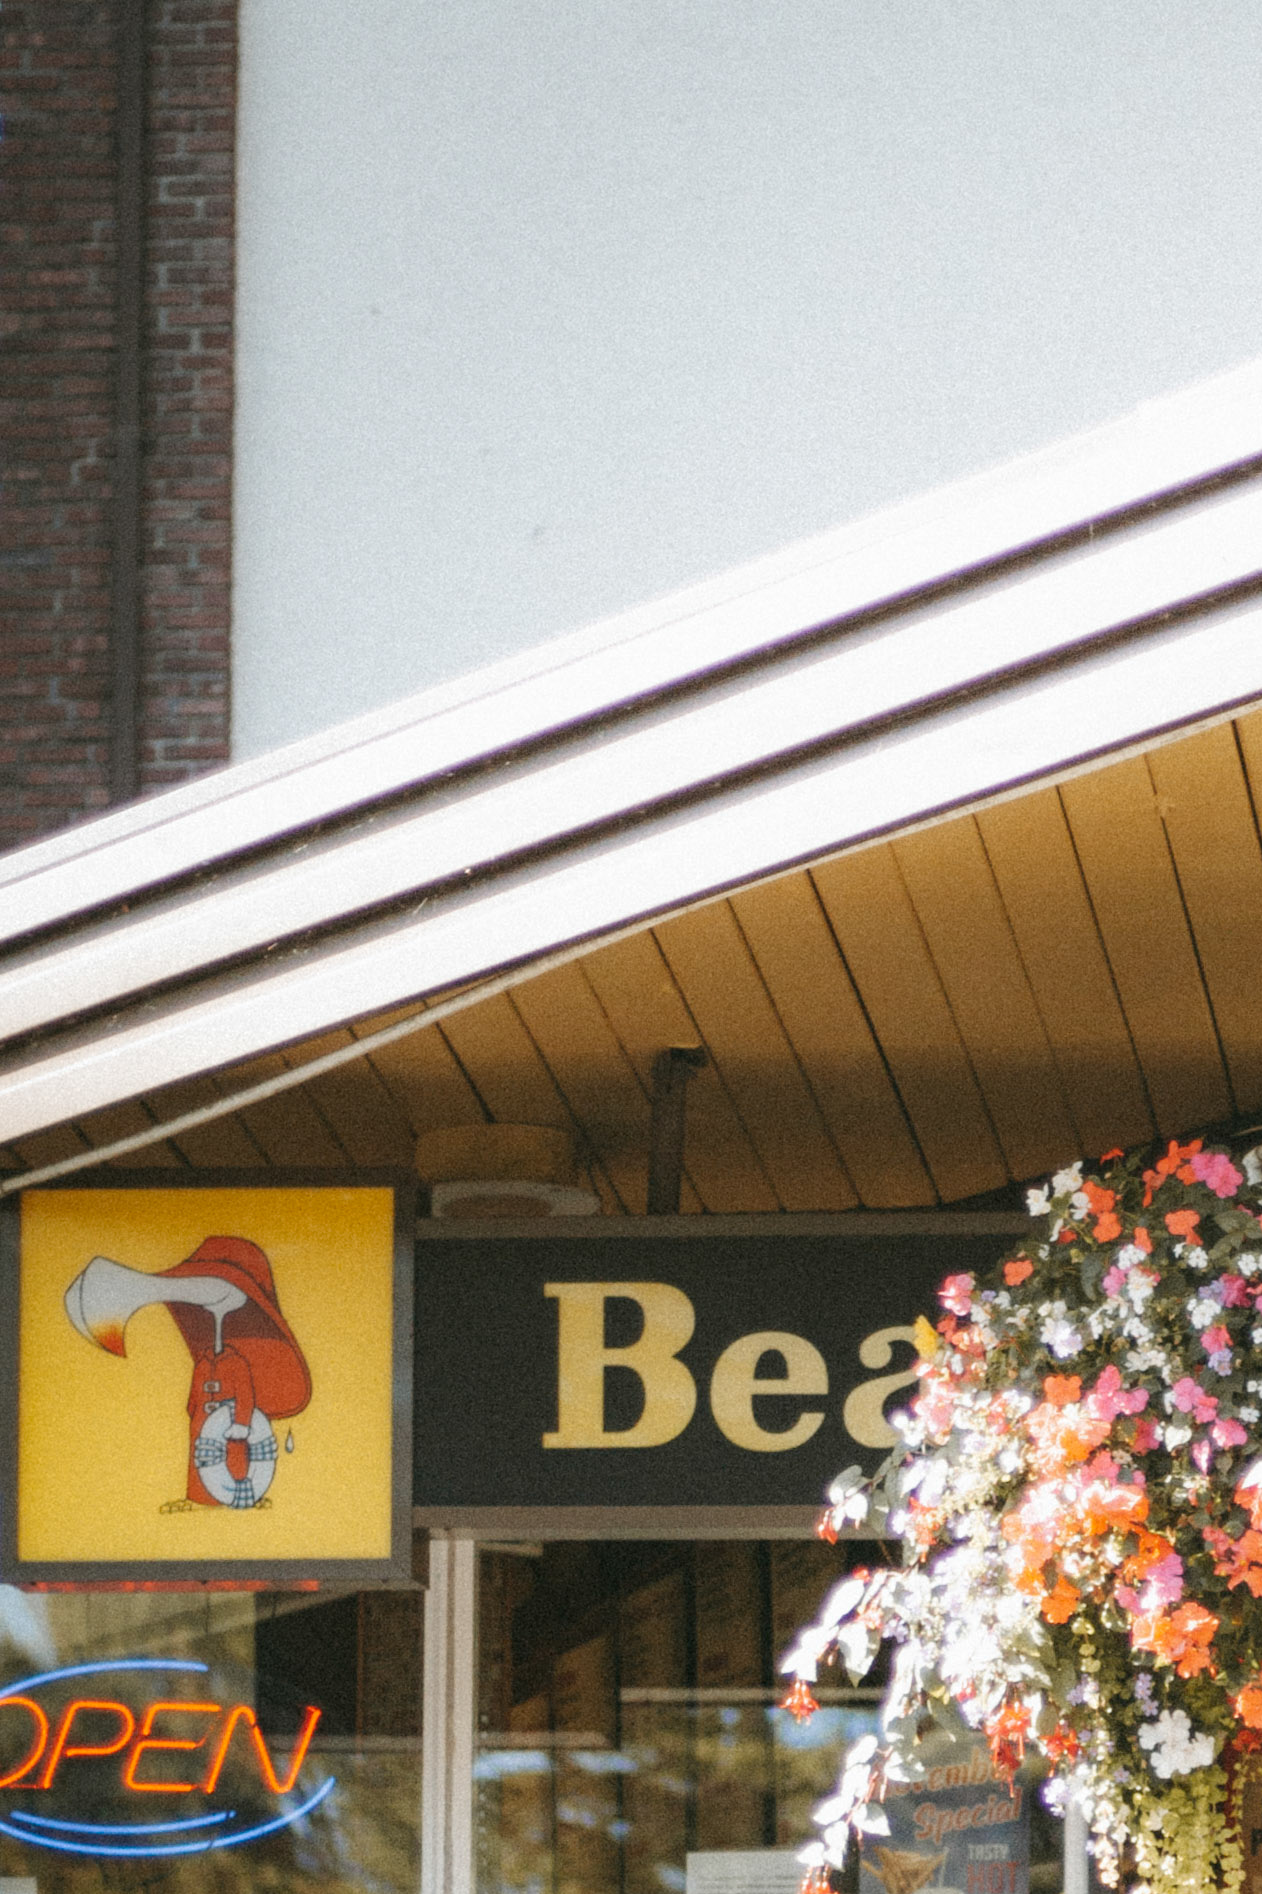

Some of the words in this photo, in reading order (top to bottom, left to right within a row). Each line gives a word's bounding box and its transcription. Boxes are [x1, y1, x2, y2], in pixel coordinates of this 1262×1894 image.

[542, 1281, 925, 1453] Bea
[0, 1695, 322, 1795] OPEN
[912, 1787, 1024, 1847] Special
[966, 1862, 1020, 1894] HOT
